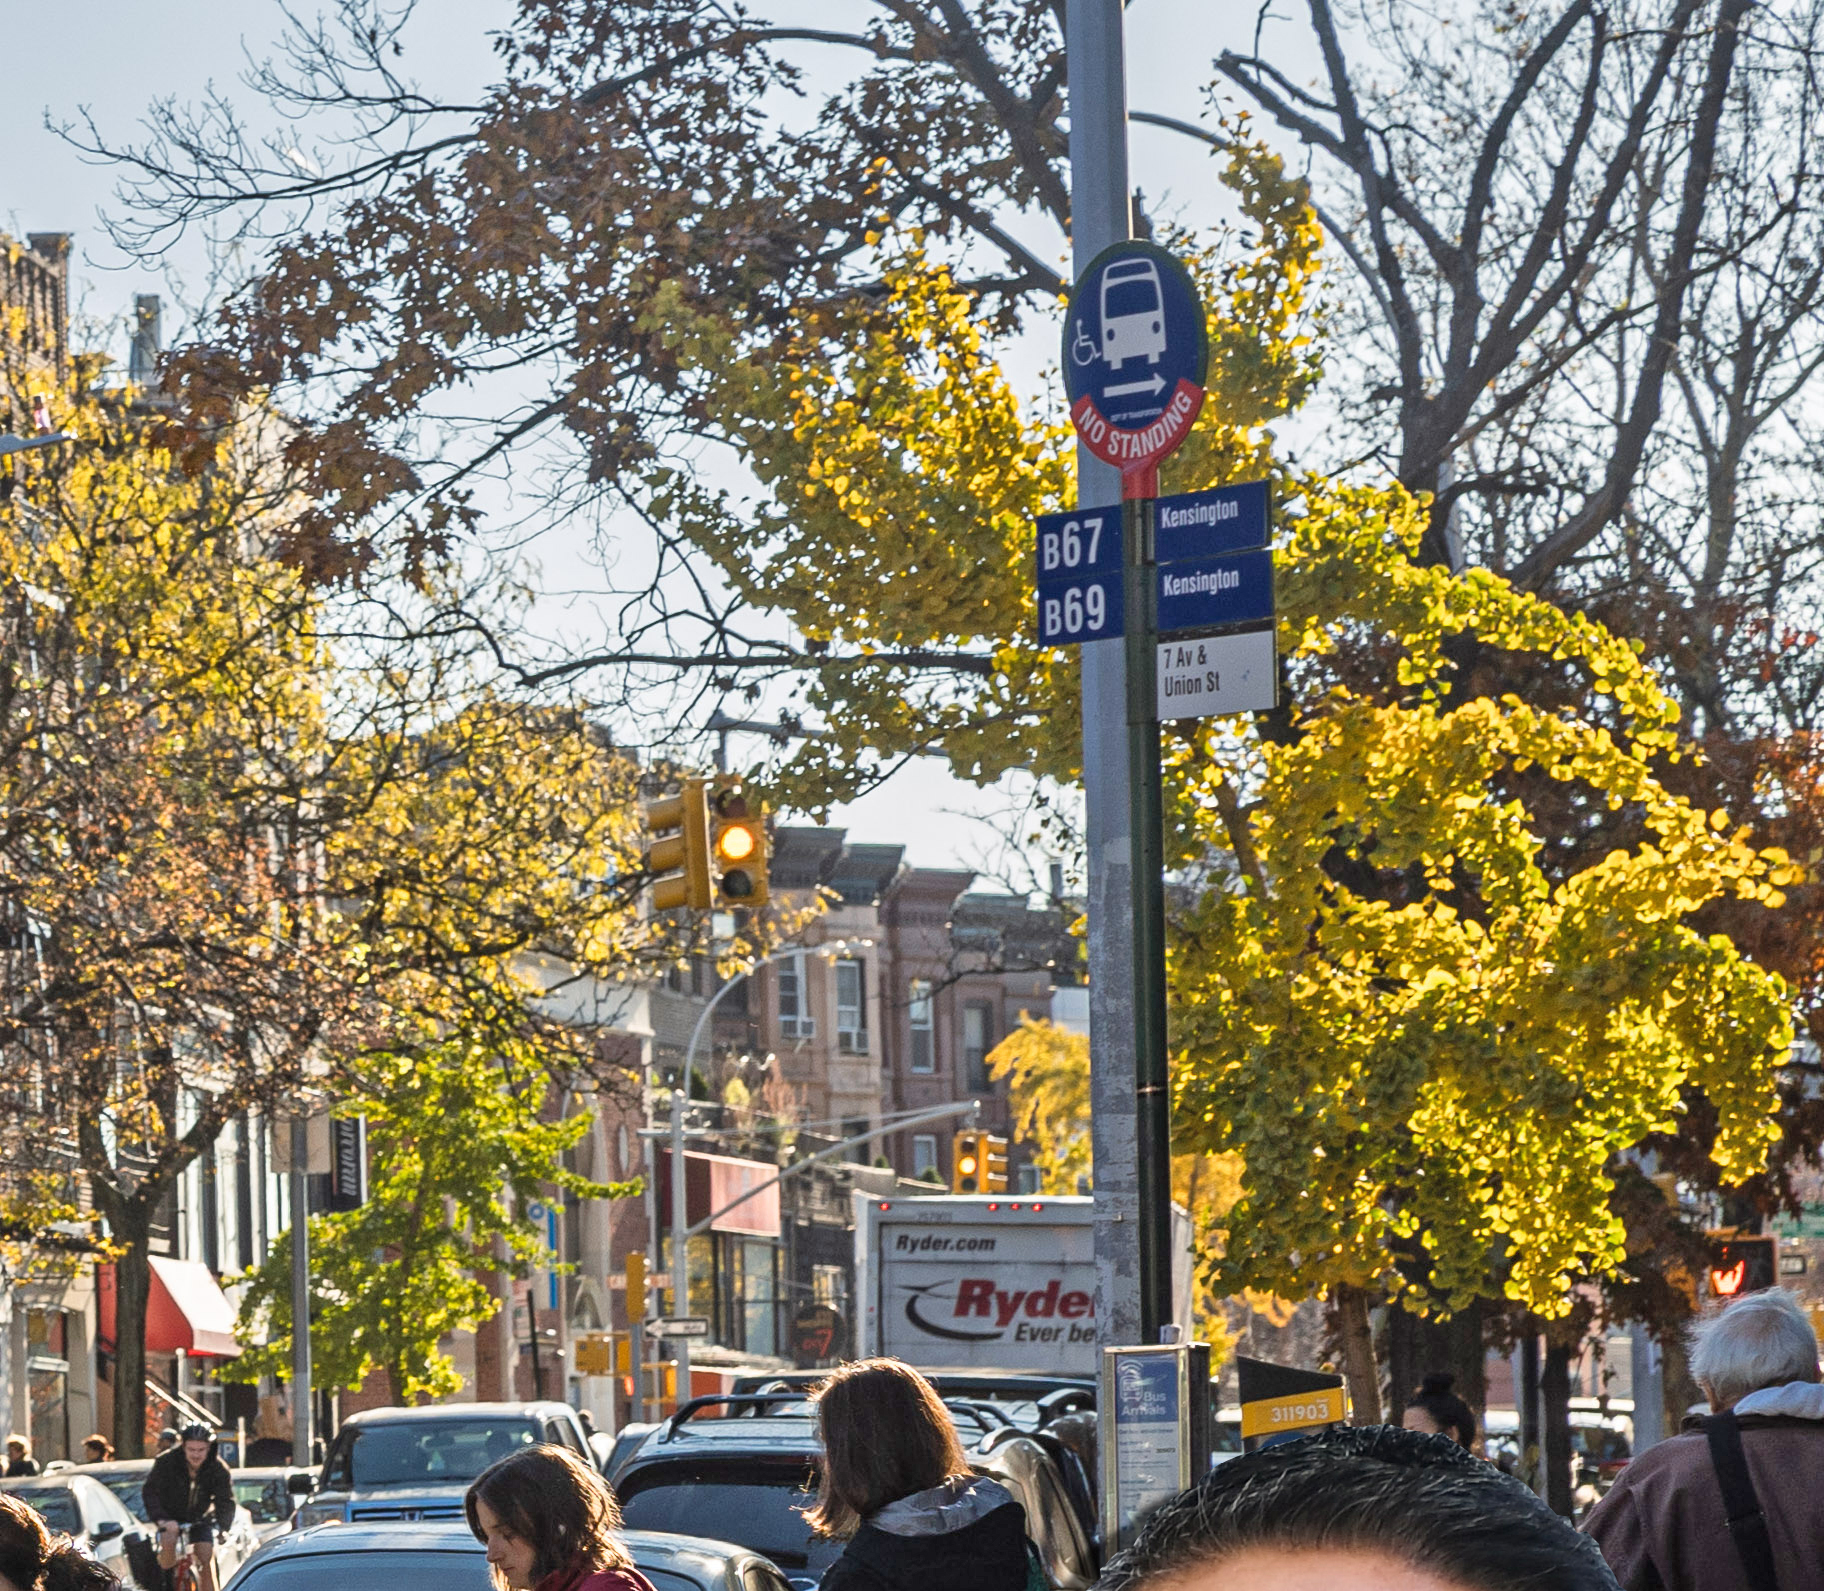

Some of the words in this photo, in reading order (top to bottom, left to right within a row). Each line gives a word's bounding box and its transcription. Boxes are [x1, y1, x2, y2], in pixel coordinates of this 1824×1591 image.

[1078, 406, 1102, 443] NO
[1107, 391, 1192, 458] STANDING
[1161, 500, 1239, 528] Kensington
[1043, 517, 1103, 570] B67
[1163, 569, 1240, 597] Kensington
[1045, 584, 1106, 637] B69
[1164, 648, 1171, 669] 7
[1176, 647, 1192, 668] Av
[1198, 645, 1207, 665] &
[1164, 673, 1202, 697] Union
[1206, 671, 1220, 692] St
[896, 1234, 996, 1255] Ryder.com
[1014, 1323, 1062, 1343] Ever
[1143, 1391, 1166, 1402] Bus
[1121, 1405, 1166, 1416] Arrivals
